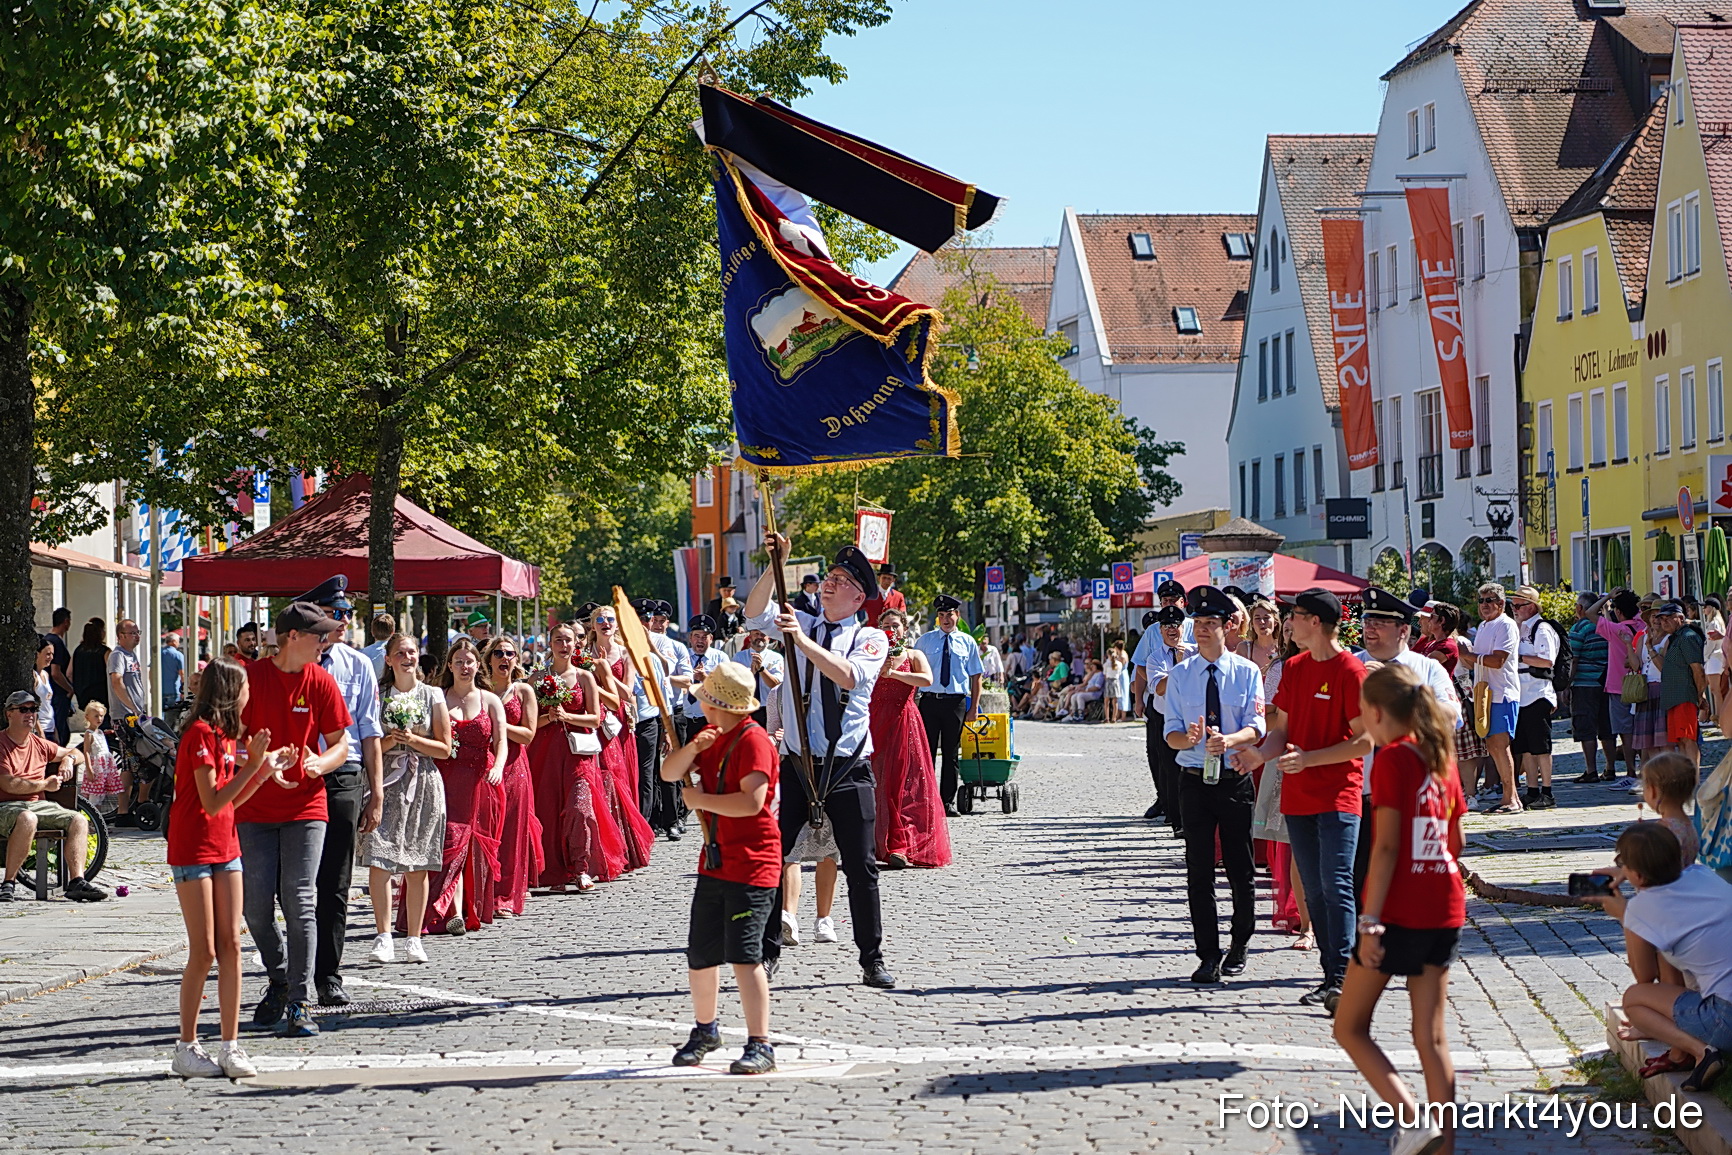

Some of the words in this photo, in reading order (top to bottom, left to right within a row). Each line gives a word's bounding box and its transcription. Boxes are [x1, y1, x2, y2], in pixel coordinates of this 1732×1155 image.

[1422, 258, 1467, 361] SALE
[1574, 350, 1601, 383] HOTEL
[1608, 345, 1638, 372] Lehmeier
[1329, 514, 1366, 523] SCHMID
[1095, 581, 1107, 598] P
[1115, 583, 1132, 591] TAXI
